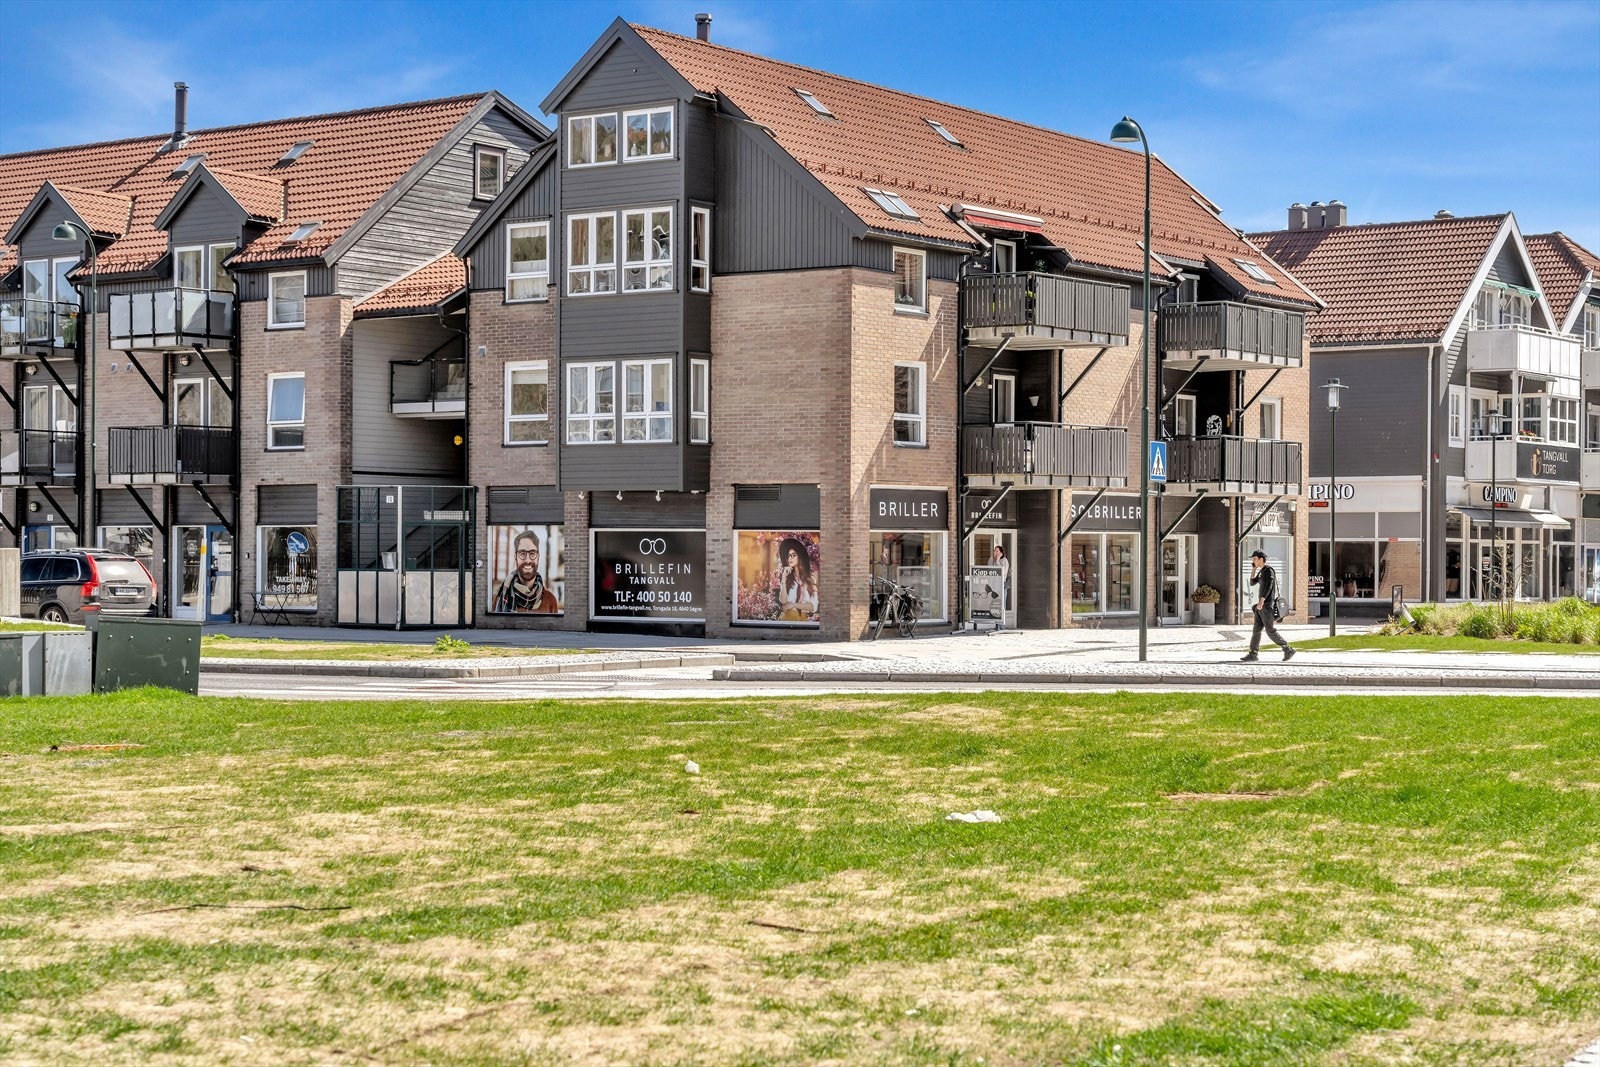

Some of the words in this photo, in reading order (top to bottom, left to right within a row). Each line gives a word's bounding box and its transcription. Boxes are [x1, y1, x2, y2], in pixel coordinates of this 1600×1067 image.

[1542, 450, 1569, 463] TANGVALL
[1542, 463, 1557, 475] TORG
[879, 501, 939, 517] BRILLER
[615, 563, 691, 574] BRILLEFIN
[629, 576, 675, 585] TANGVALL
[272, 584, 286, 593] 949
[614, 590, 635, 603] TLF:
[636, 590, 656, 603] 400
[657, 591, 671, 603] 50
[673, 591, 692, 603] 140
